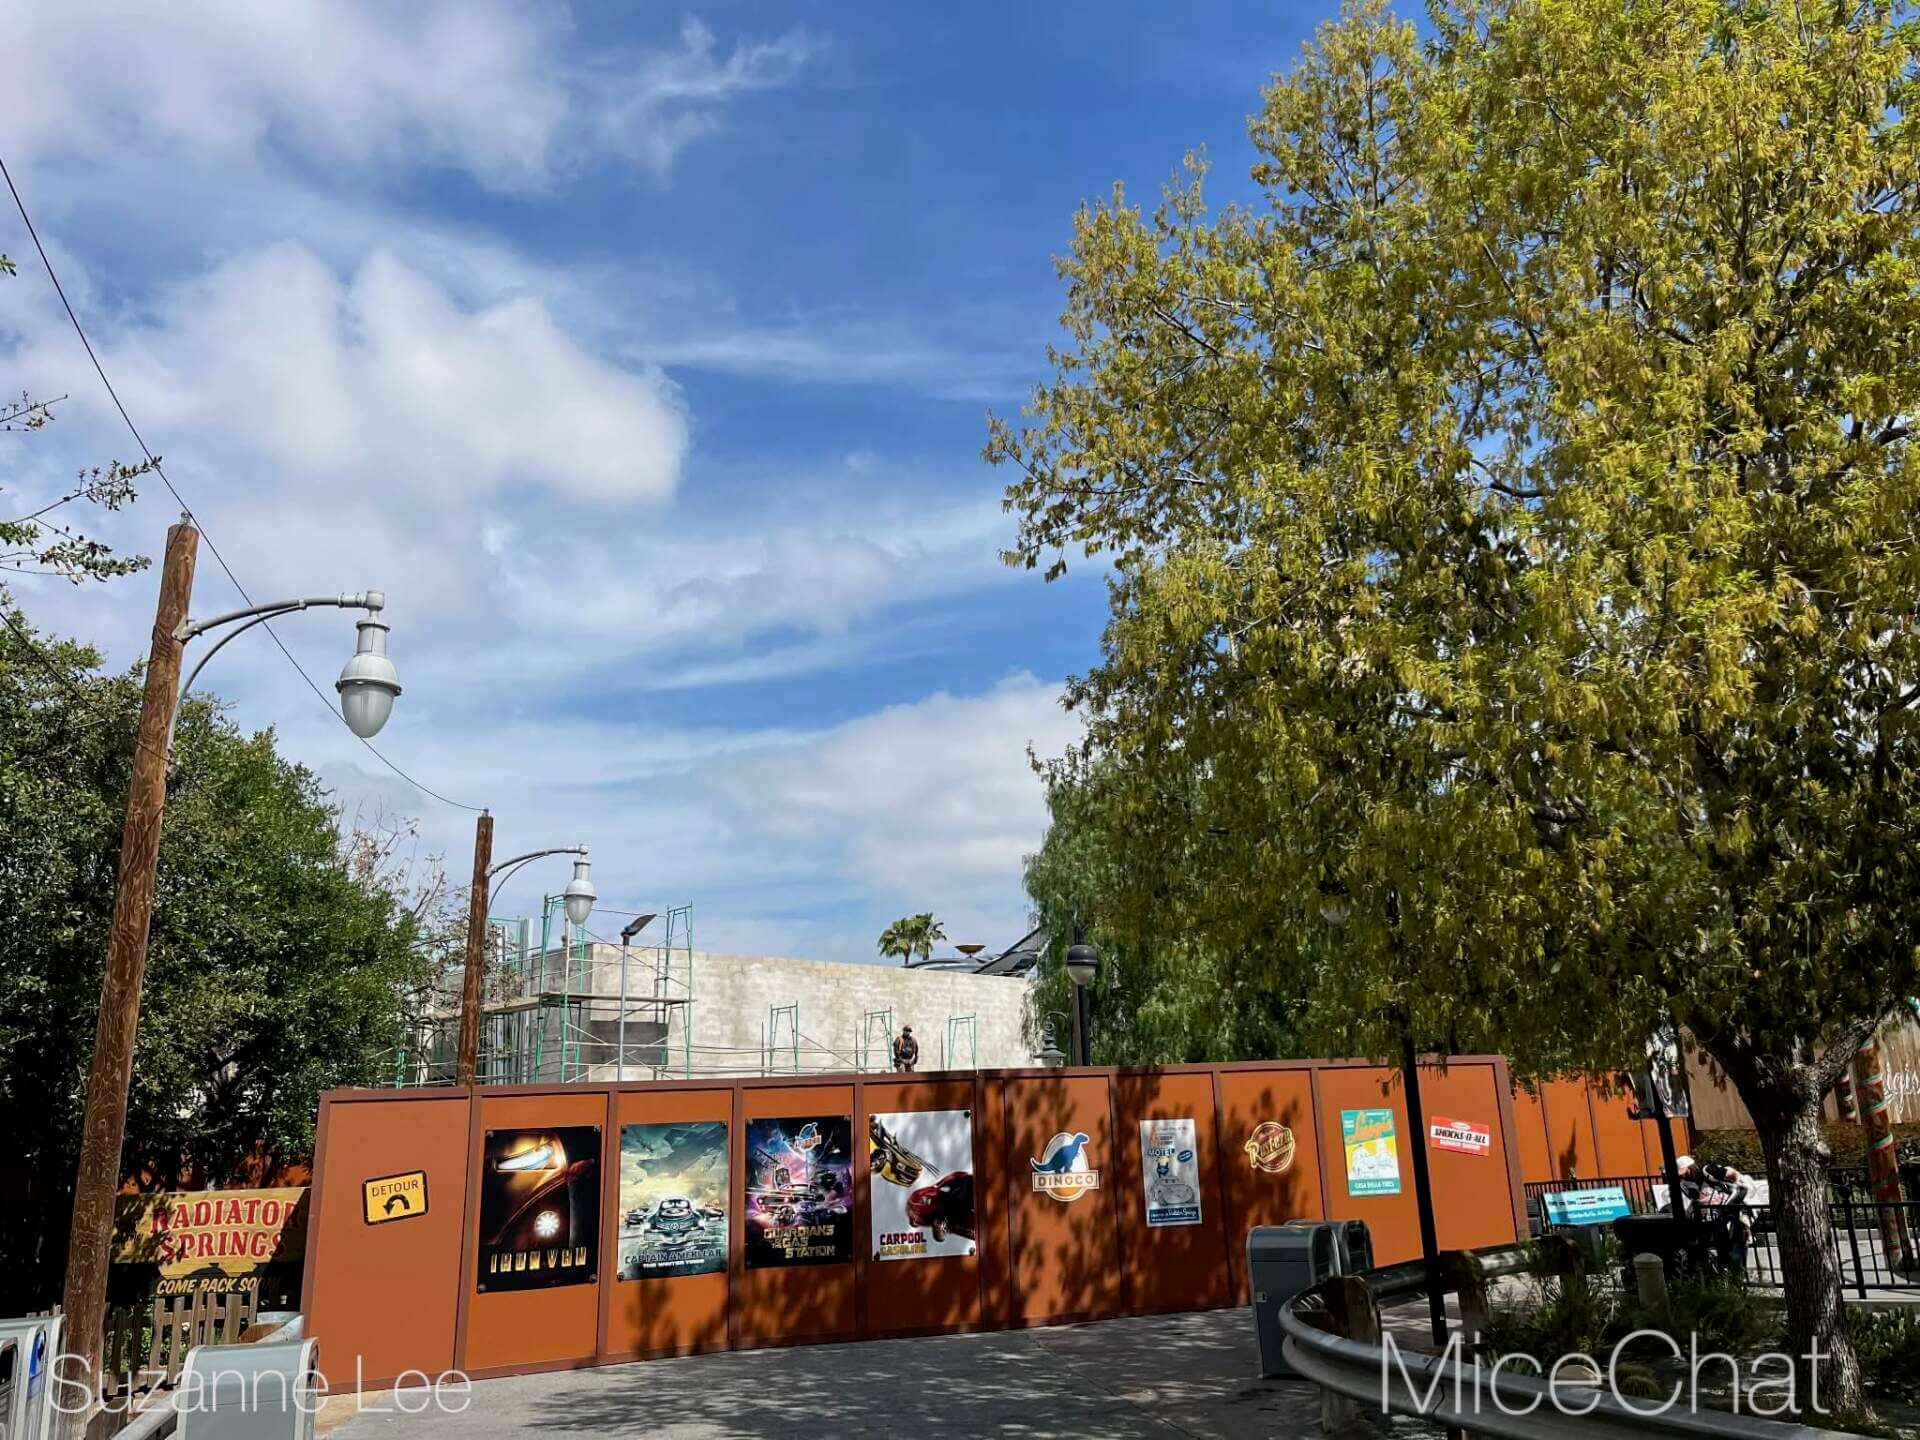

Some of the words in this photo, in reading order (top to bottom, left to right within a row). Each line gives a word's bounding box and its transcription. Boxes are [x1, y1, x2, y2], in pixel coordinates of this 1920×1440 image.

[1038, 1175, 1094, 1187] DINOCO
[372, 1180, 418, 1197] DETOUR
[763, 1225, 835, 1239] GUARDIANS
[880, 1232, 926, 1245] CARPOOL
[159, 1231, 285, 1264] SPRINGS
[782, 1237, 809, 1248] GAS
[624, 1250, 668, 1265] CAPTAIN
[784, 1245, 835, 1259] STATION
[156, 1277, 197, 1295] COME
[199, 1277, 238, 1293] BACK
